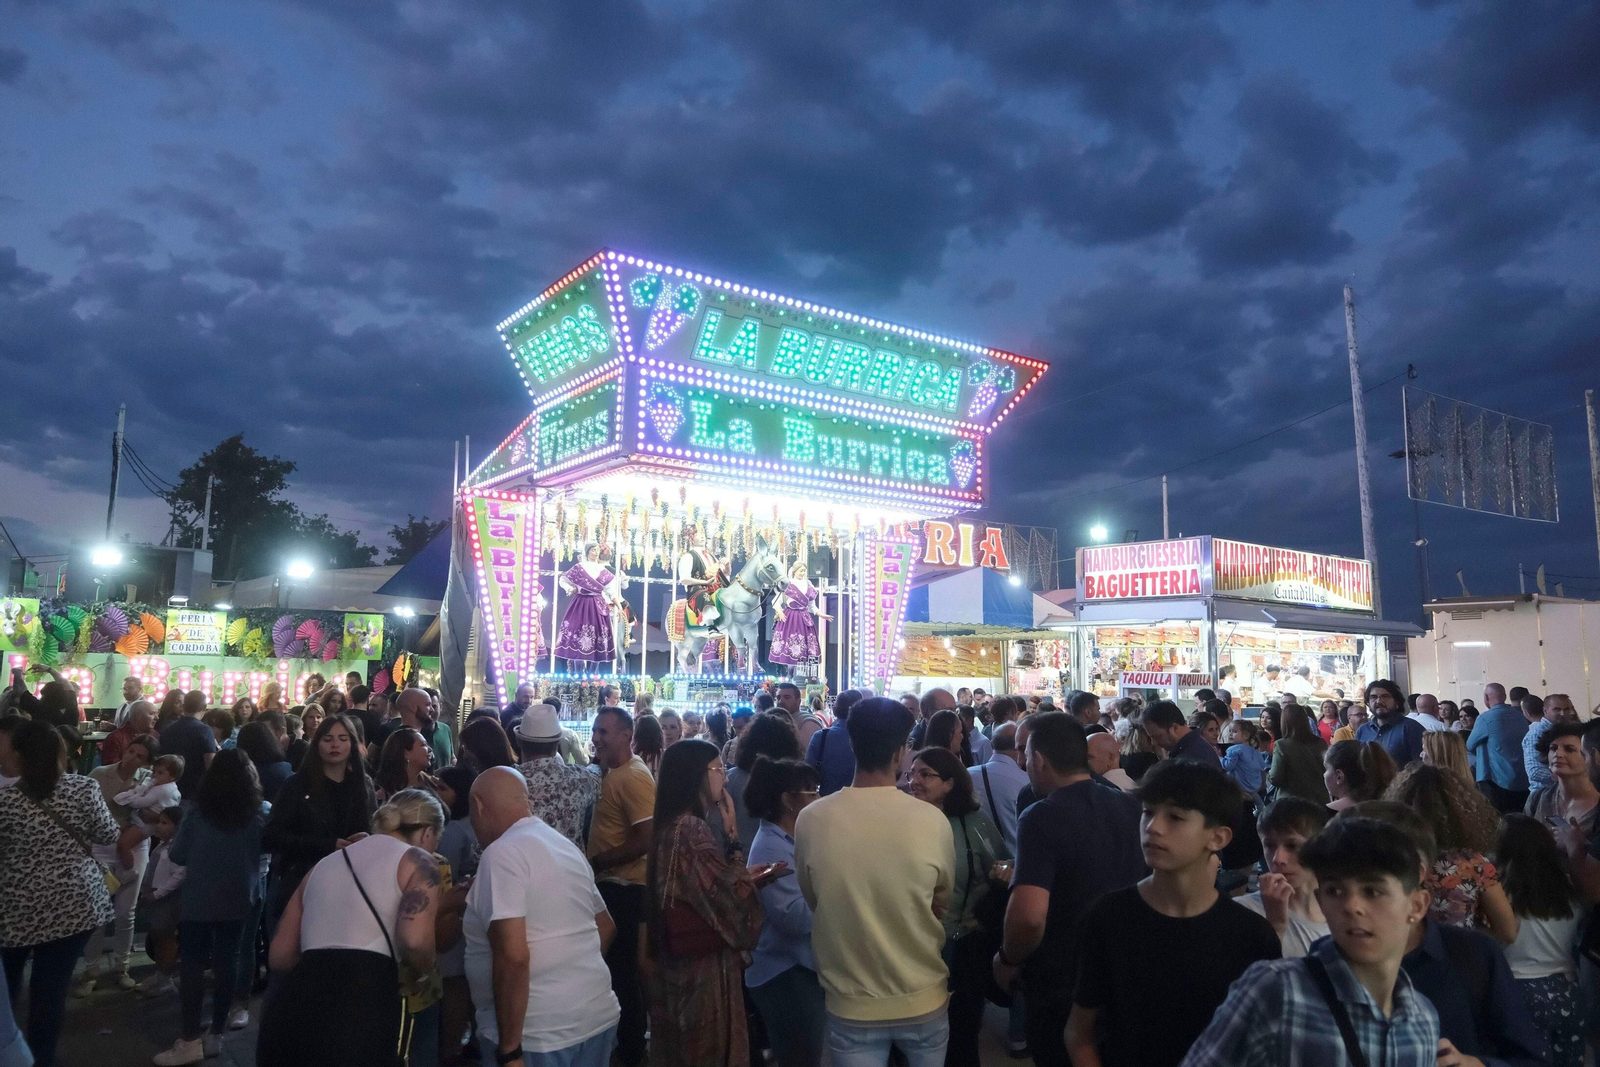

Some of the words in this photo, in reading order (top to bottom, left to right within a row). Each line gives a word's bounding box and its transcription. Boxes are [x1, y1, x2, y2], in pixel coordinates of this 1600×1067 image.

[517, 304, 610, 384] VINOS
[694, 309, 760, 371] LA
[769, 327, 964, 414] BURRICA
[540, 409, 609, 466] Vinos
[689, 400, 756, 455] La
[782, 417, 950, 486] Burrica
[485, 499, 516, 540] La
[882, 543, 903, 575] La
[1084, 540, 1201, 572] HAMBURGUESERIA
[1085, 568, 1201, 599] BAGUETTERIA
[180, 614, 214, 624] FERIA
[490, 546, 519, 672] Burrica
[189, 629, 204, 638] DE
[876, 580, 900, 679] Burrica
[171, 643, 219, 653] CORDOBA
[1122, 672, 1172, 685] TAQUILLA
[1178, 673, 1211, 686] TAQUILLA
